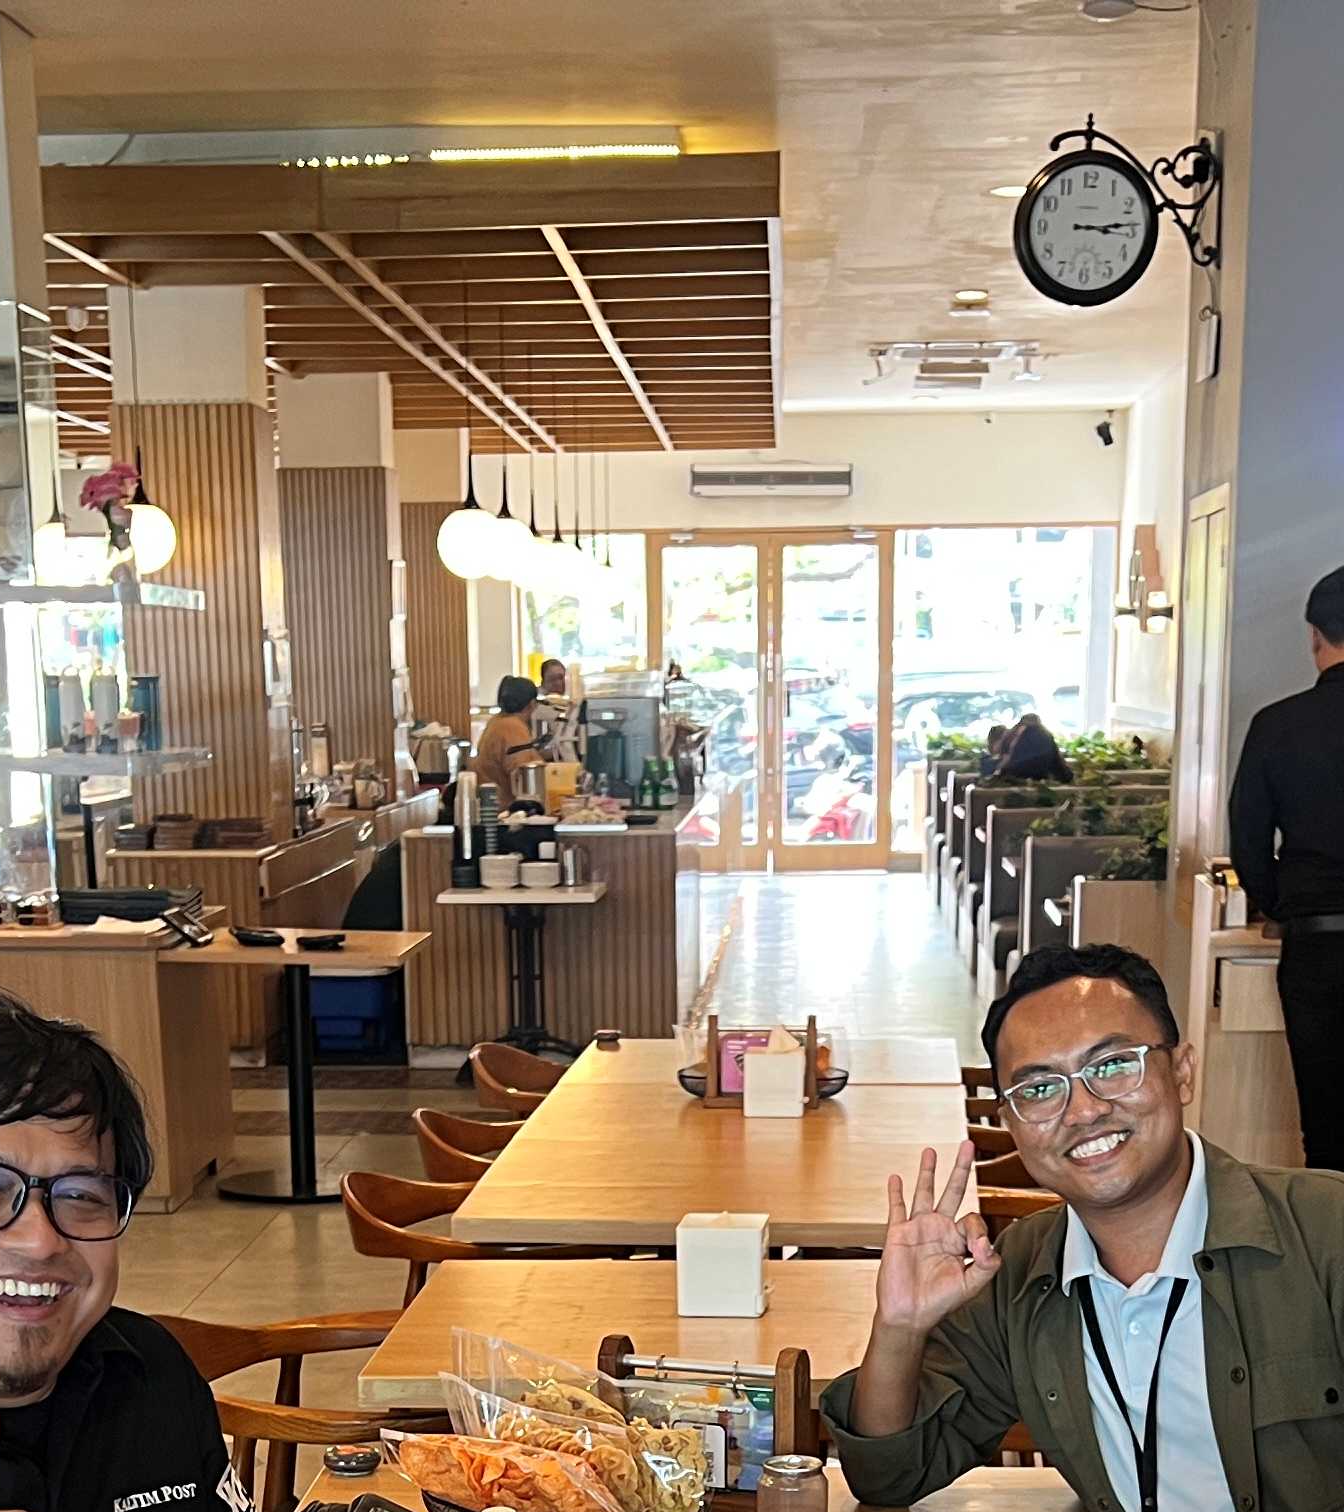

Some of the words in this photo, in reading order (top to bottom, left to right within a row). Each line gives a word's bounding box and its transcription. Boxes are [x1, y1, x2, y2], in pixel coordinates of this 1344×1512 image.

[1060, 178, 1073, 196] 11
[1083, 171, 1100, 189] 12
[1111, 179, 1118, 197] 1
[1043, 195, 1058, 212] 10
[1122, 196, 1134, 215] 2
[1037, 219, 1048, 235] 9
[1042, 243, 1053, 259] 8
[1119, 243, 1127, 262] 4
[1058, 260, 1067, 278] 7
[1078, 266, 1090, 284] 6
[1102, 260, 1114, 279] 5
[160, 1483, 197, 1502] POST
